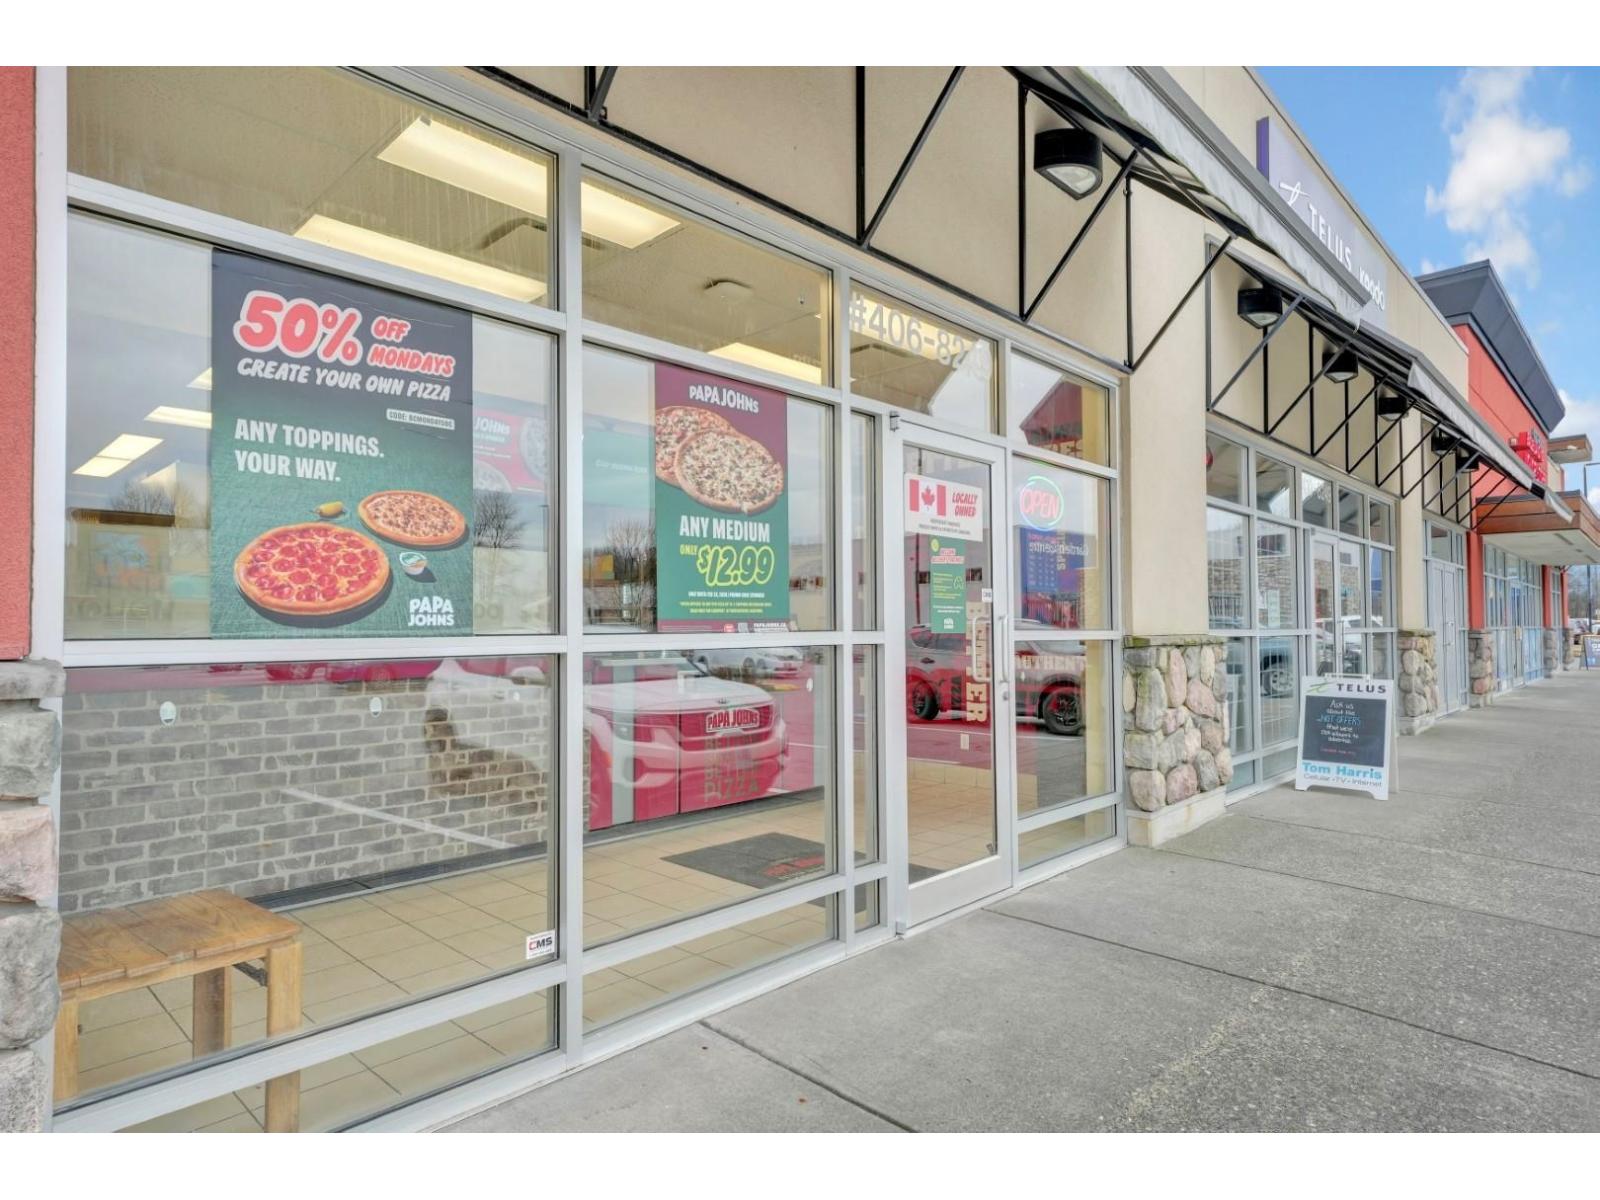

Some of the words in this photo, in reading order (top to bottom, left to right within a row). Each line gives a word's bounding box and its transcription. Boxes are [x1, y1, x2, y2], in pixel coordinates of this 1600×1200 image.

[1308, 202, 1352, 270] TELUS
[233, 289, 363, 367] 50%
[371, 315, 411, 343] OFF
[367, 345, 456, 377] MONDAYS
[237, 357, 312, 384] CREATE
[315, 367, 361, 391] YOUR
[365, 375, 404, 396] OWN
[407, 380, 452, 402] PIZZA
[688, 384, 720, 405] PAPA
[720, 388, 760, 414] JOHNS
[234, 418, 278, 444] ANY
[282, 424, 385, 458] TOPPINGS.
[234, 449, 291, 478] YOUR
[295, 457, 342, 483] WAY.
[952, 492, 978, 505] LOCALLY
[954, 505, 977, 517] OWNED
[1021, 488, 1060, 520] OPEN
[679, 515, 709, 538] ANY
[712, 519, 771, 544] MEDIUM
[680, 544, 698, 556] ONLY
[696, 544, 775, 587] $12.99
[408, 595, 455, 614] PAPA
[407, 613, 455, 627] JOHNS
[1336, 683, 1387, 694] TELUS
[707, 711, 731, 729] PAPA
[1302, 762, 1331, 774] Tom
[1336, 764, 1382, 780] Harris
[529, 936, 552, 951] CMS
